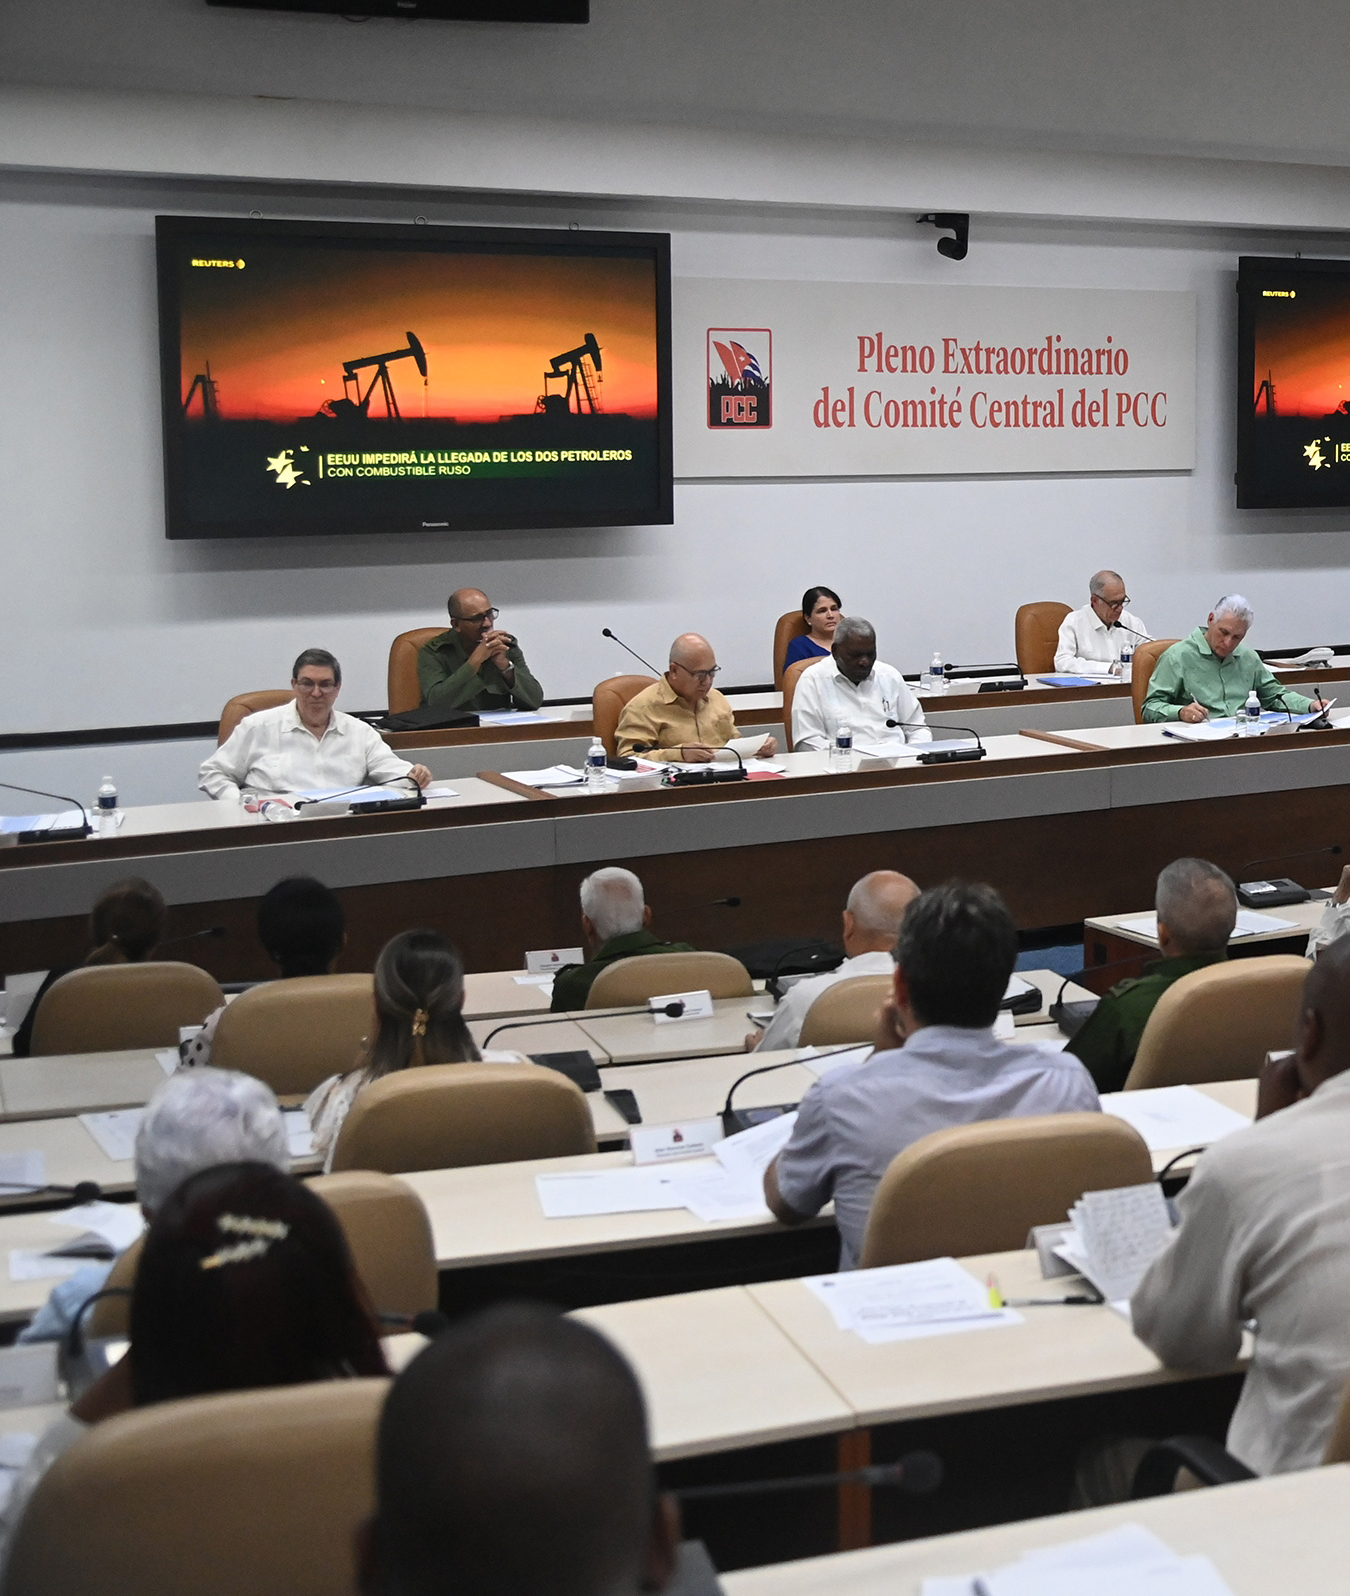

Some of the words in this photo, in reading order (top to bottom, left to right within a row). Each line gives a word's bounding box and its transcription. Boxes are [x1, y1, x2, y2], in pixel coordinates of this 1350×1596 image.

[191, 259, 235, 268] REUTERS
[857, 332, 935, 374] Pleno
[942, 335, 1129, 377] Extraordinario
[721, 395, 757, 423] PCC
[813, 386, 856, 428] del
[863, 385, 963, 429] Comité
[970, 390, 1065, 428] Central
[1071, 388, 1110, 428] del
[1116, 392, 1167, 427] PCC
[327, 453, 360, 465] EEUU
[362, 450, 418, 465] IMPEDIRÁ
[420, 453, 436, 464] LA
[437, 452, 491, 463] LLEGADA
[492, 451, 509, 463] DE
[510, 451, 533, 462] LOS
[535, 450, 559, 462] DOS
[560, 449, 633, 462] PETROLEROS
[327, 467, 354, 478] CON
[355, 466, 436, 477] COMBUSTIBLE
[438, 465, 471, 476] RUSO
